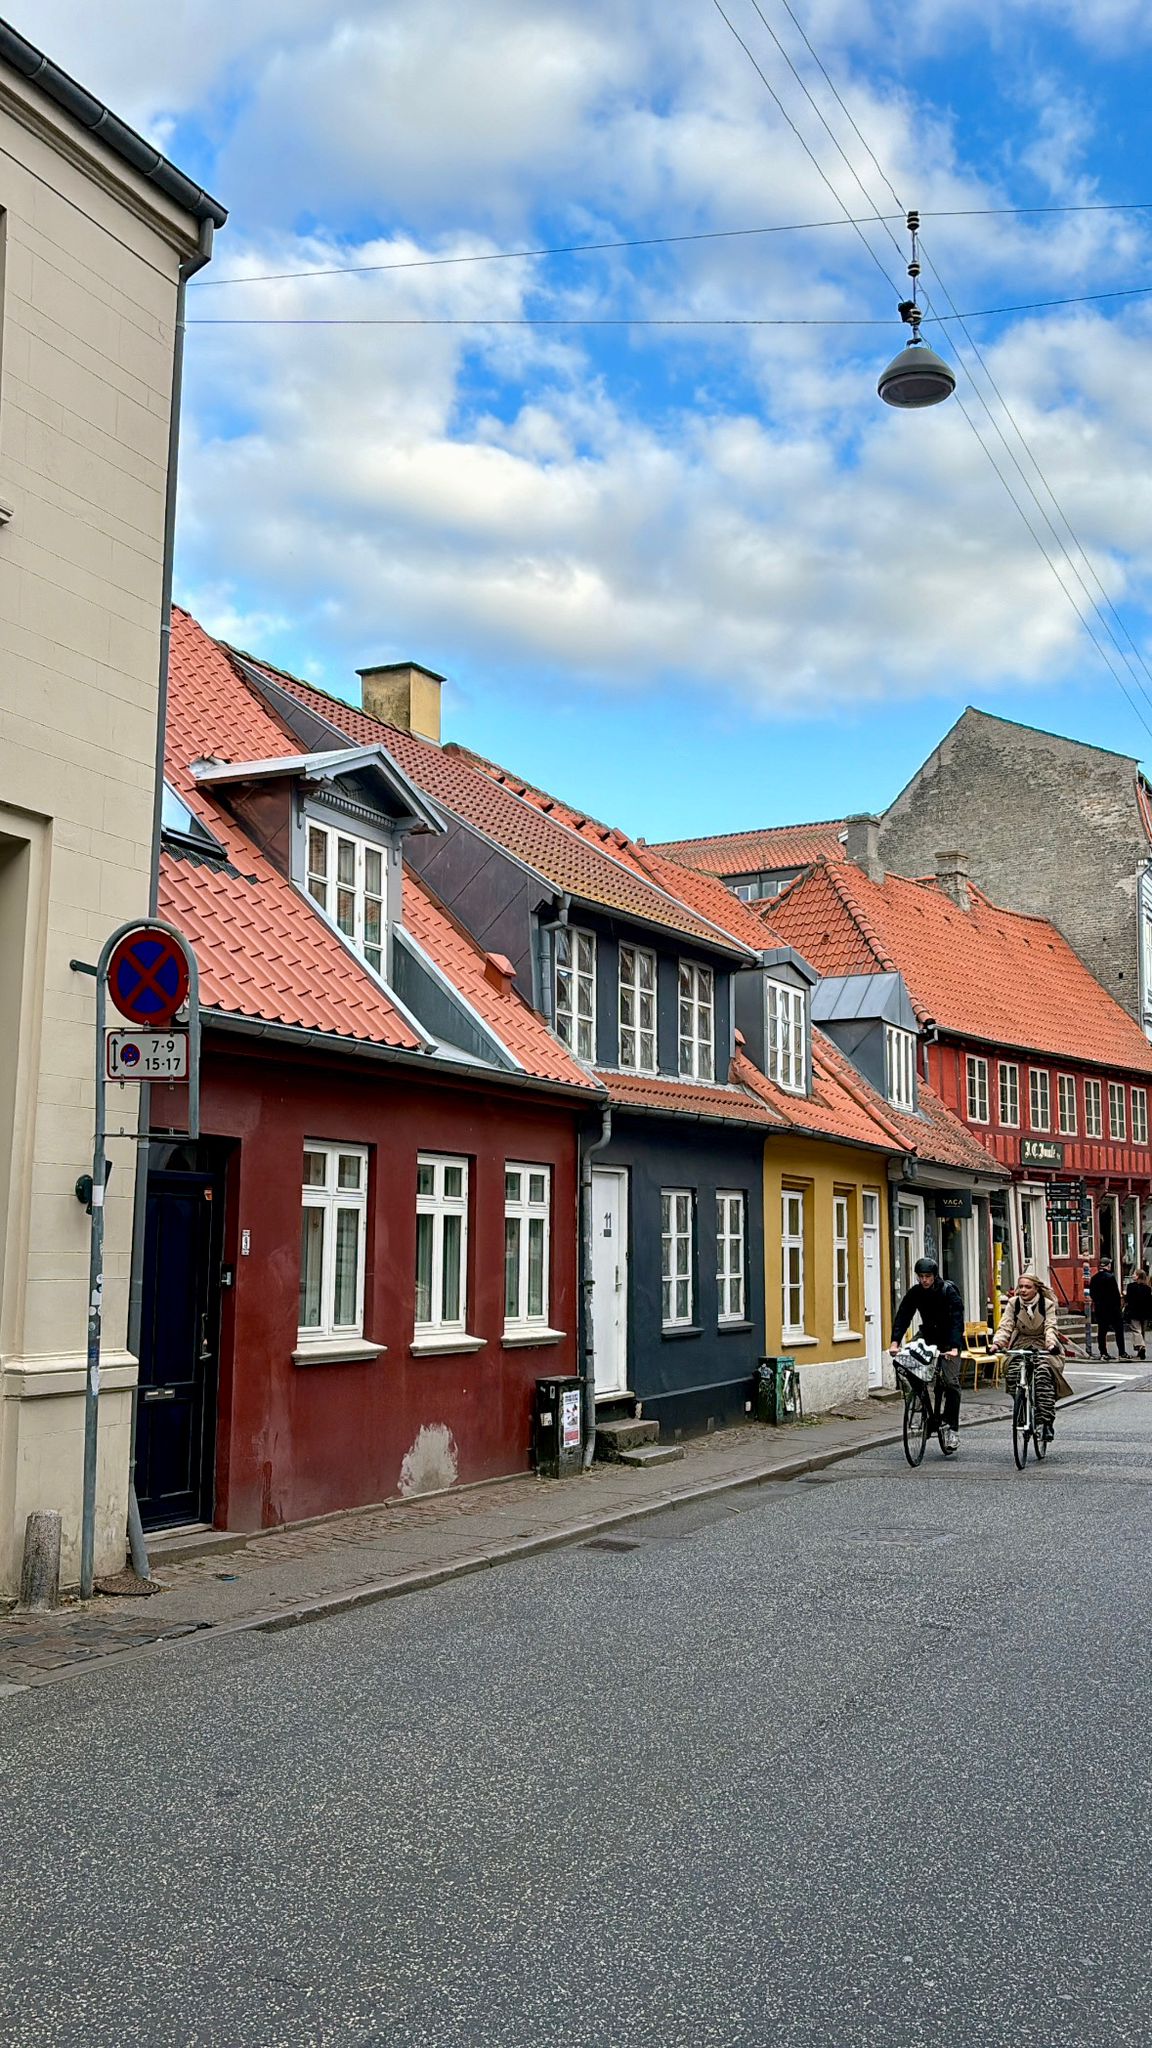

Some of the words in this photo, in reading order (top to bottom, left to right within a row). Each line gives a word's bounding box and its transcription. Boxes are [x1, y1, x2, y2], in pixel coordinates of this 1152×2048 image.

[152, 1040, 175, 1053] 7-9
[145, 1058, 181, 1070] 15-17
[604, 1212, 611, 1228] 11
